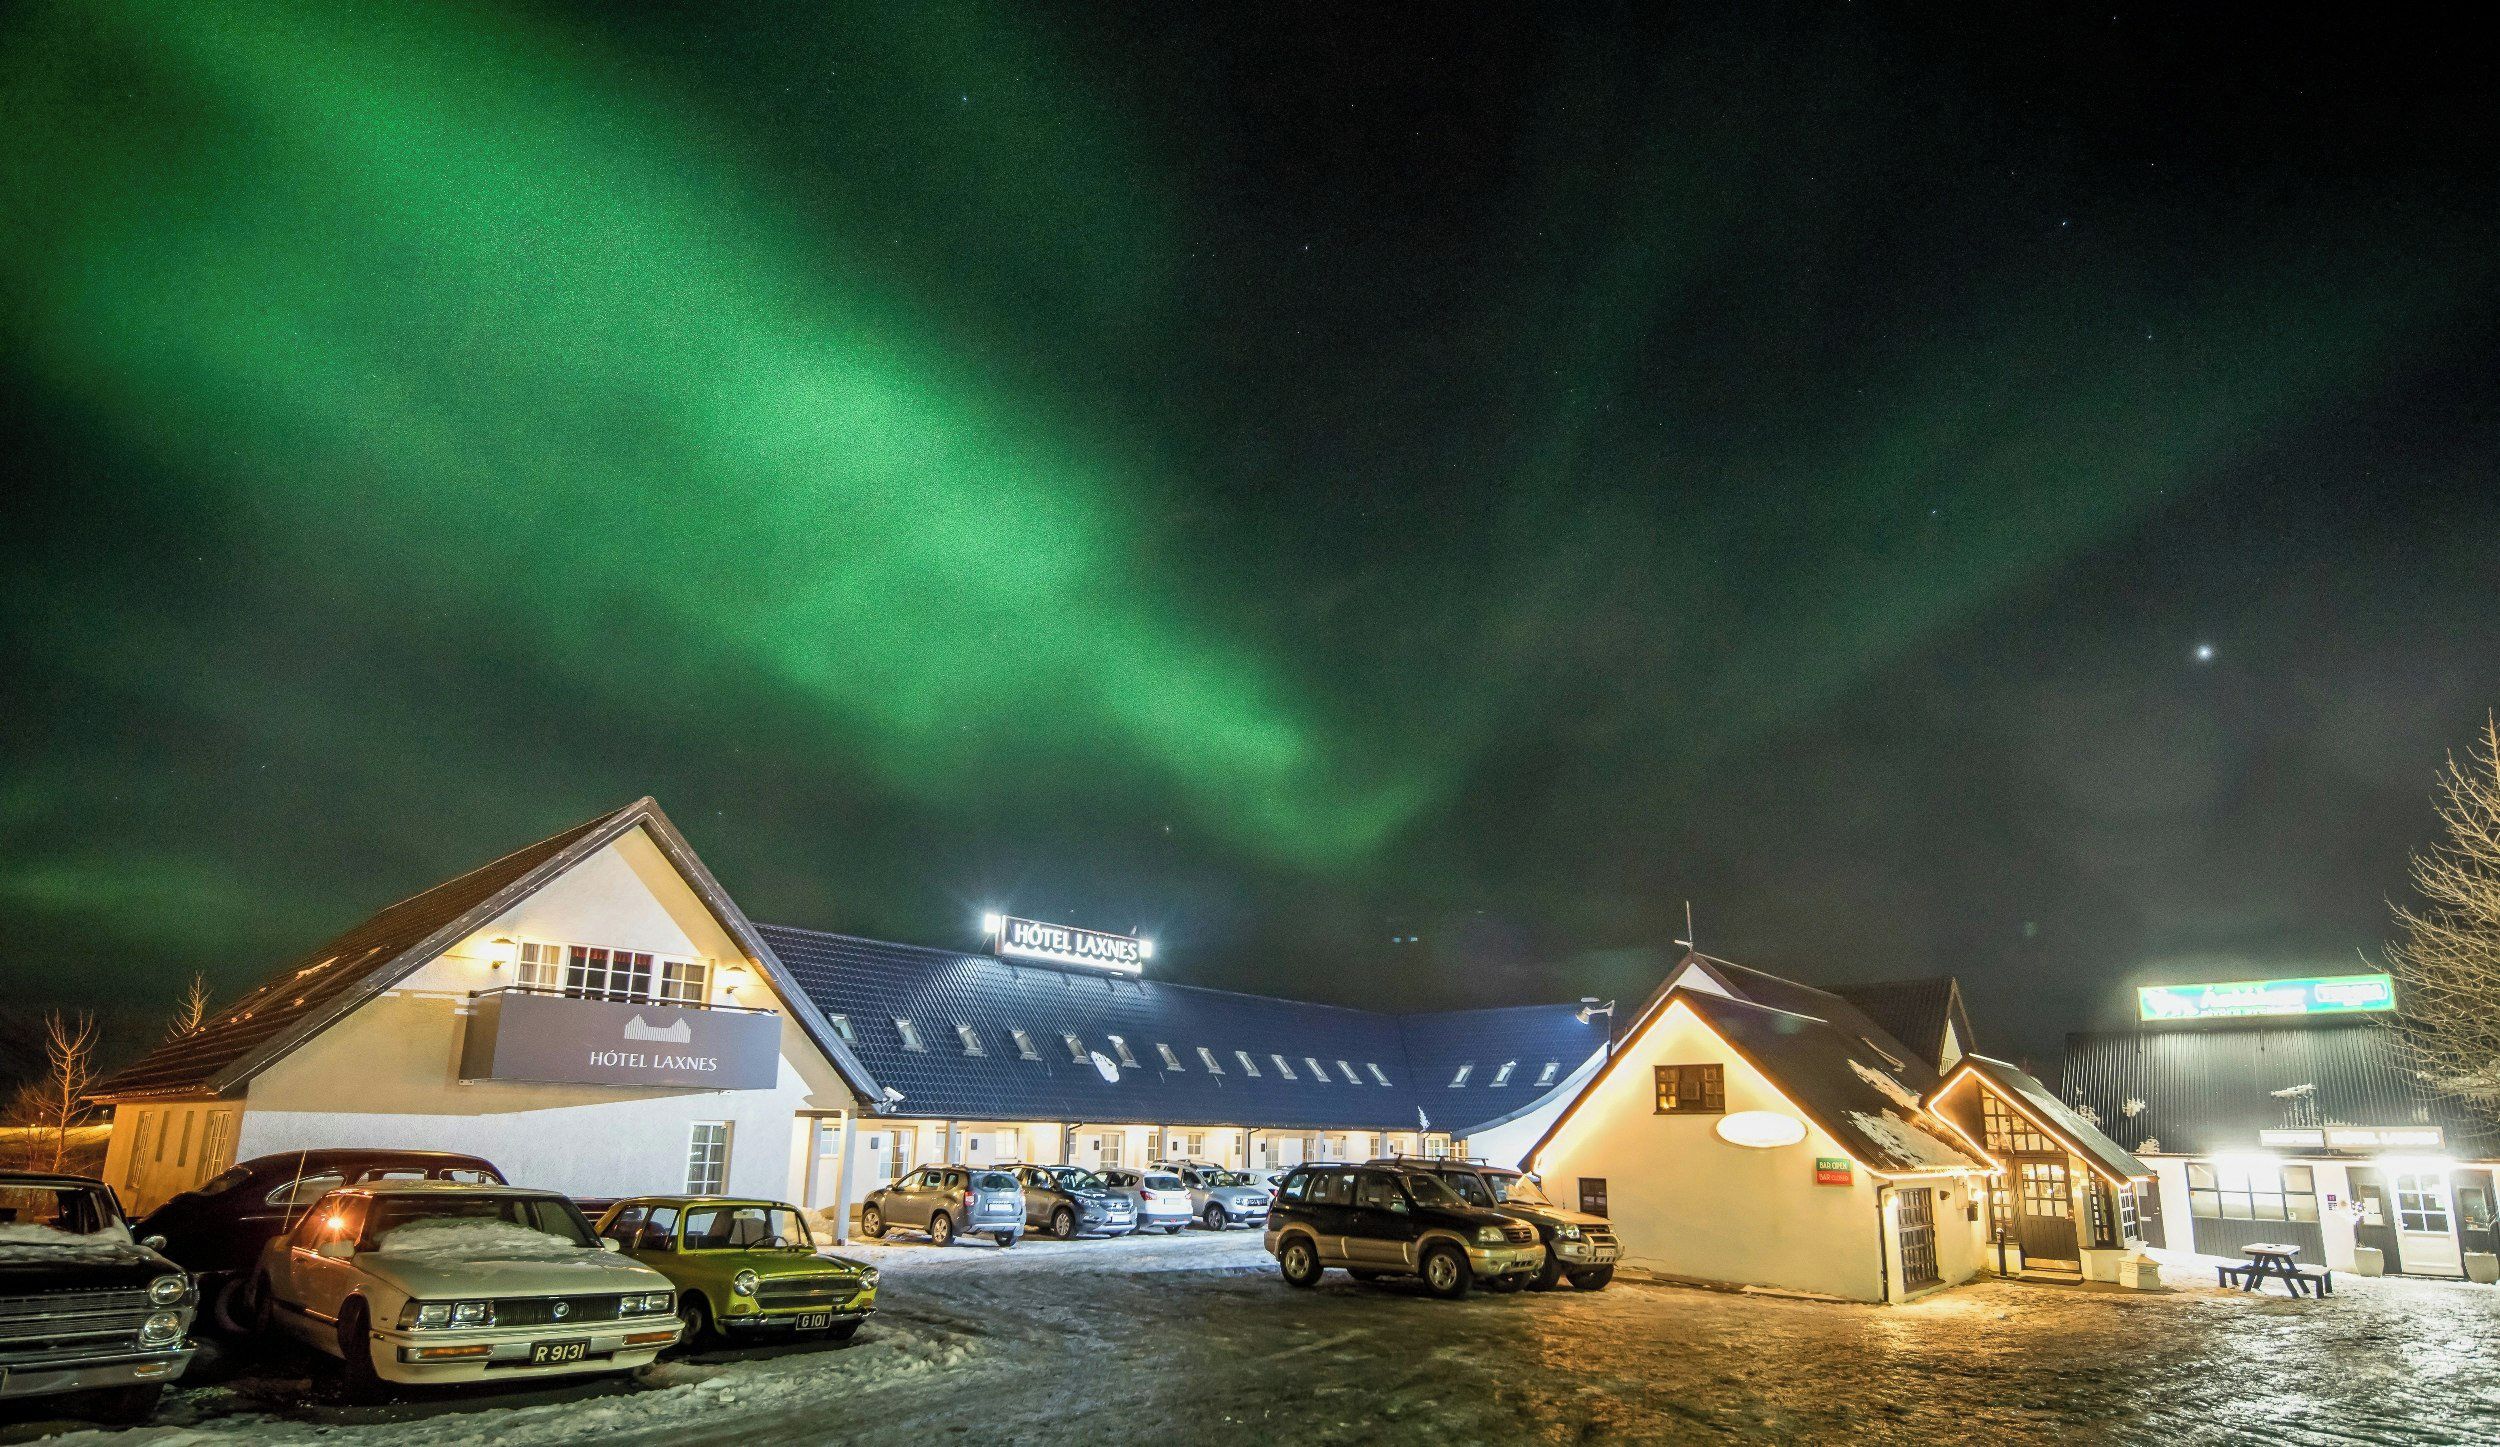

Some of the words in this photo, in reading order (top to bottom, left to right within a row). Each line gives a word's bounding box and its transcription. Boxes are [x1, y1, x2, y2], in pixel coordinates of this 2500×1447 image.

[1014, 923, 1072, 950] HÓTEL
[1075, 933, 1138, 961] LAXNES
[590, 1049, 648, 1068] HÓTEL
[653, 1054, 718, 1072] LAXNES
[1819, 1161, 1831, 1170] BAR
[801, 1315, 810, 1328] G
[810, 1314, 826, 1327] 101
[535, 1346, 549, 1362] R
[550, 1343, 586, 1361] 9131
